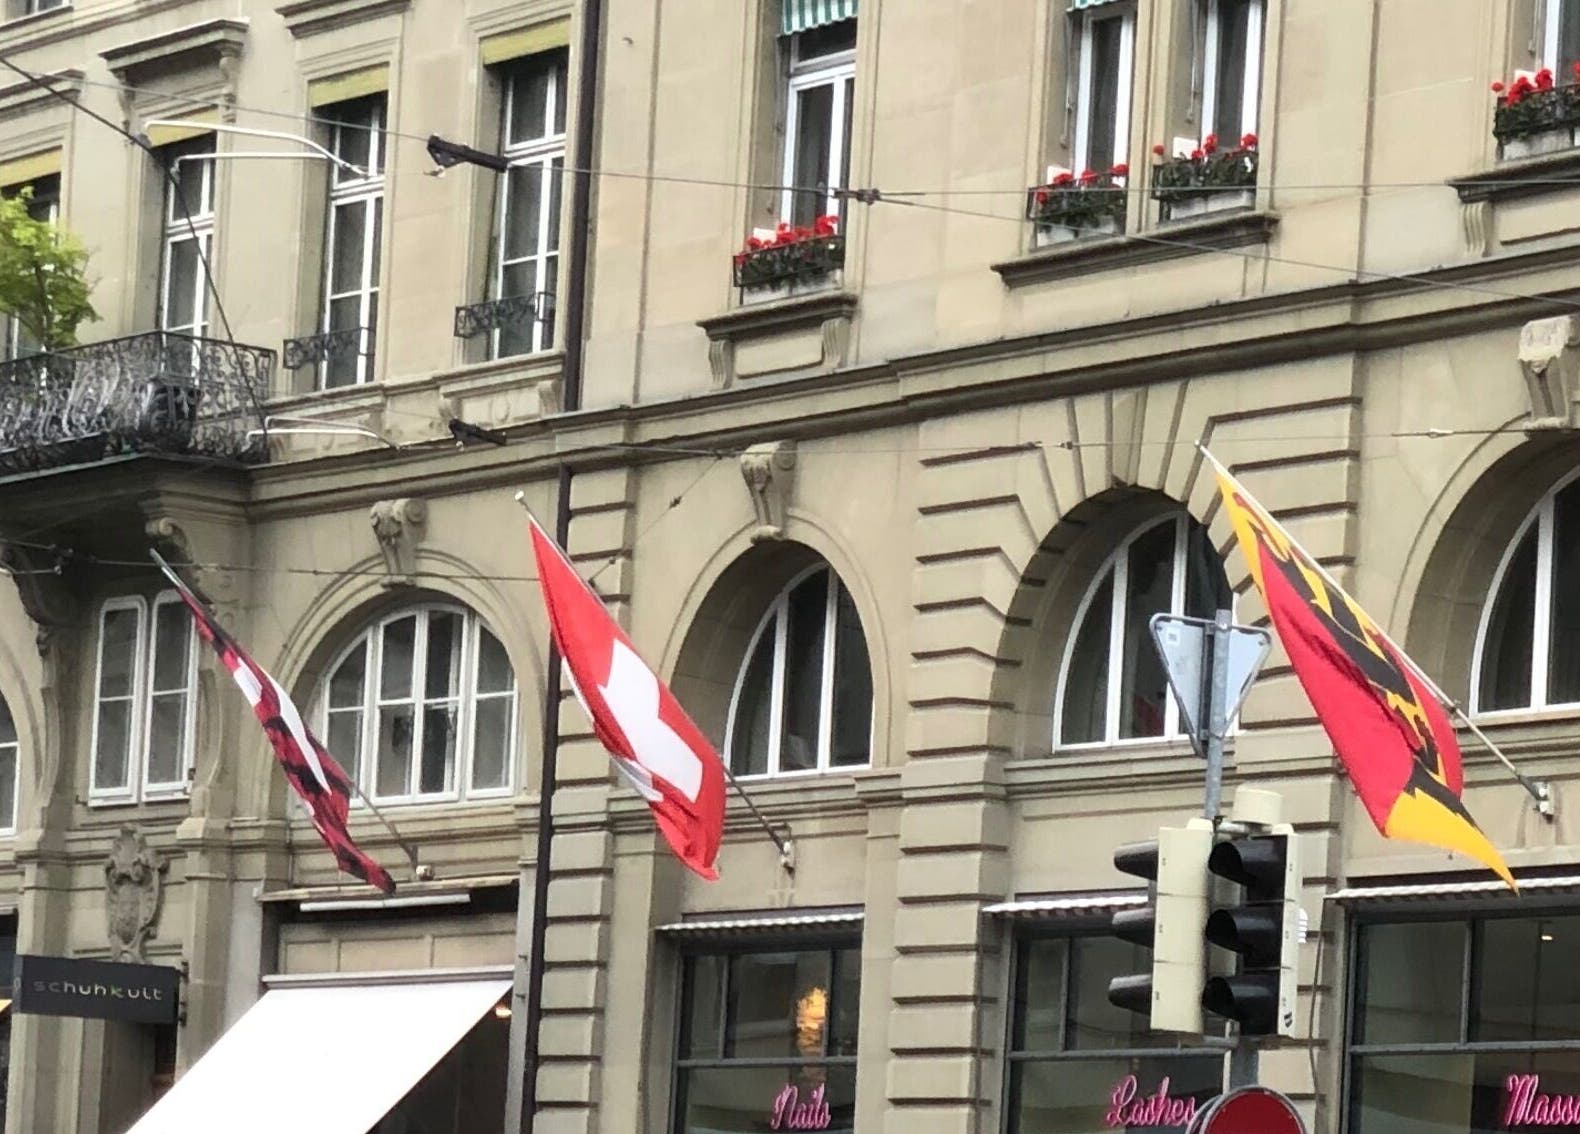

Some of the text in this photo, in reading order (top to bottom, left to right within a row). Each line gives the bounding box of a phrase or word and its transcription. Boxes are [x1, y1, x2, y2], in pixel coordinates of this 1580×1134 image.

[33, 980, 163, 1001] schuhkult
[770, 1082, 831, 1130] Nails
[1106, 1074, 1196, 1127] Lashes
